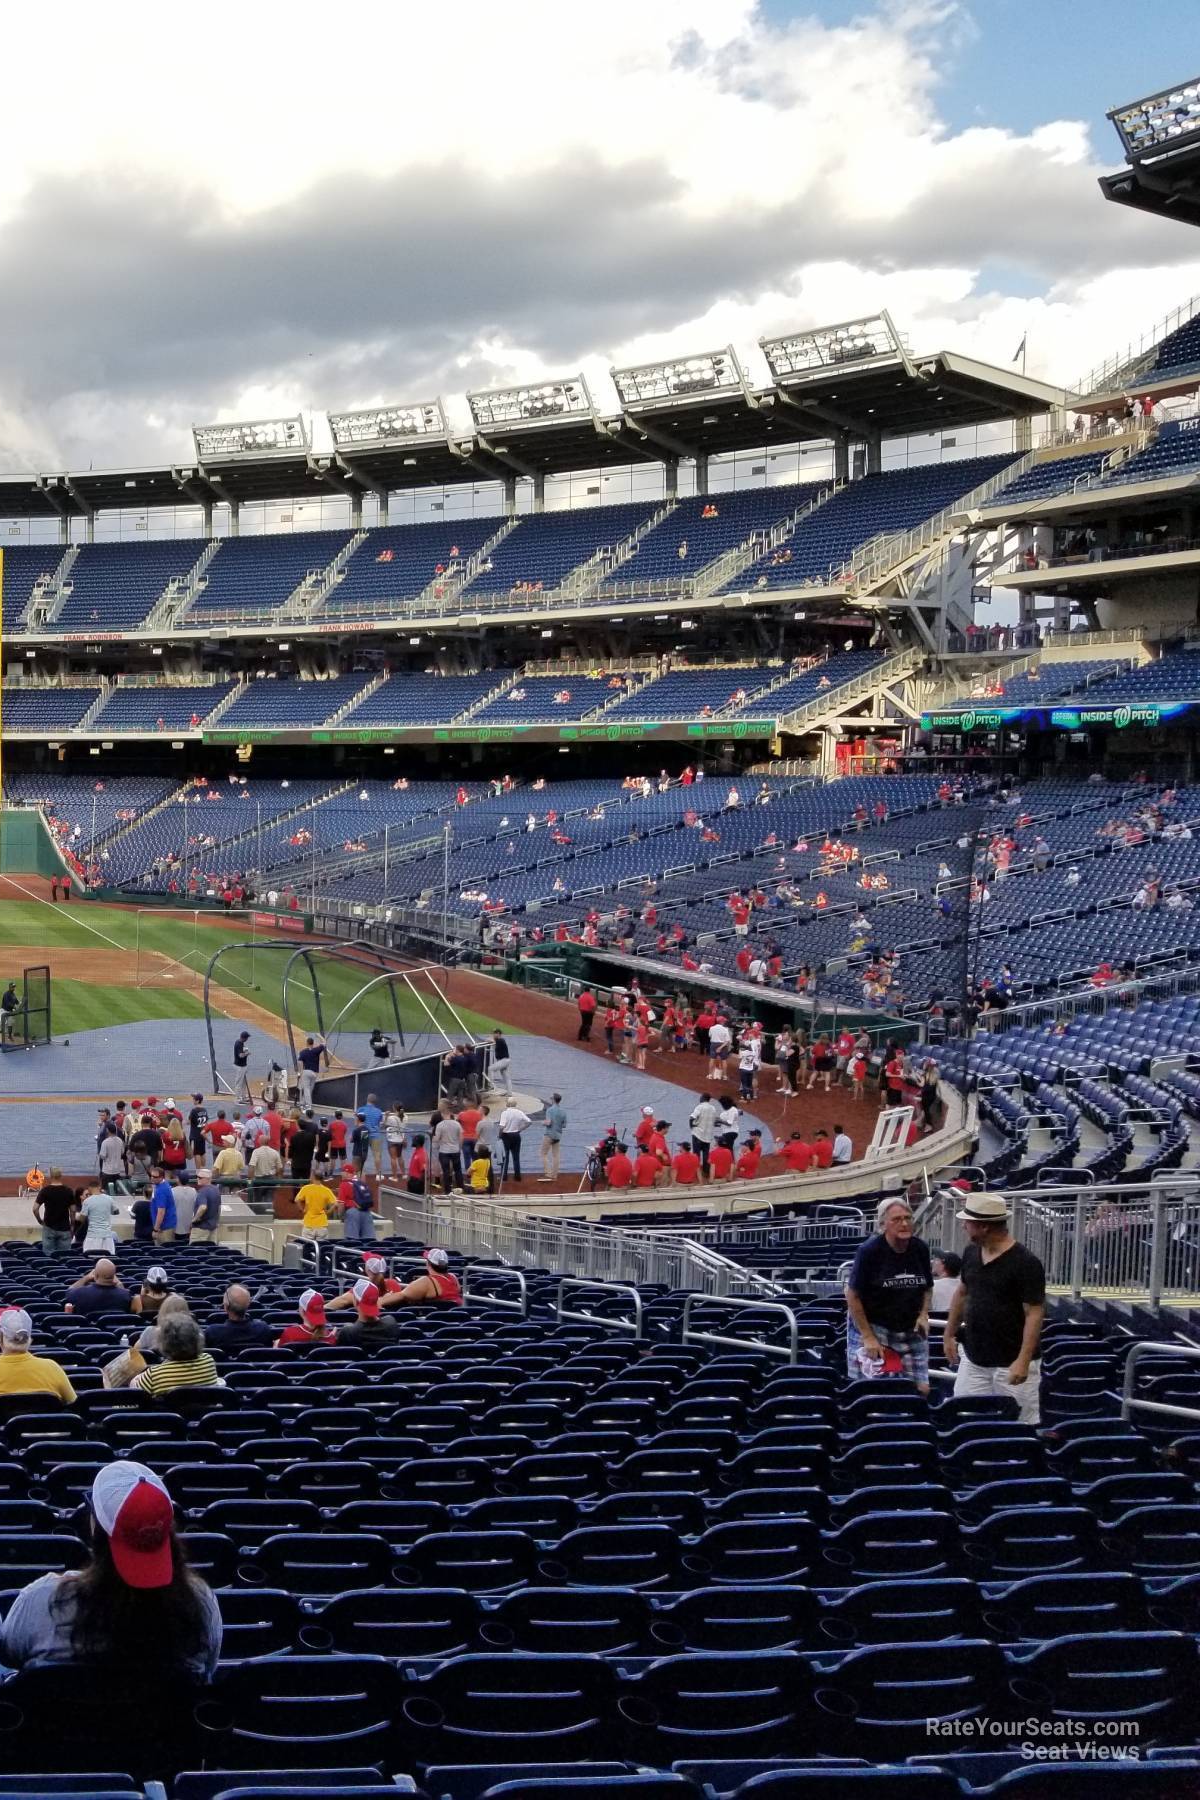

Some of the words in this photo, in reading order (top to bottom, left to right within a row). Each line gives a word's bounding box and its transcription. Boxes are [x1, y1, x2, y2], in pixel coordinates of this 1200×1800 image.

[320, 624, 342, 632] FRANK
[344, 623, 375, 632] HOWARD
[932, 716, 960, 725] INSIDE
[976, 714, 1000, 724] PITCH
[1080, 711, 1112, 722] INSIDE
[1132, 710, 1159, 720] PITCH
[174, 1140, 180, 1150] 7
